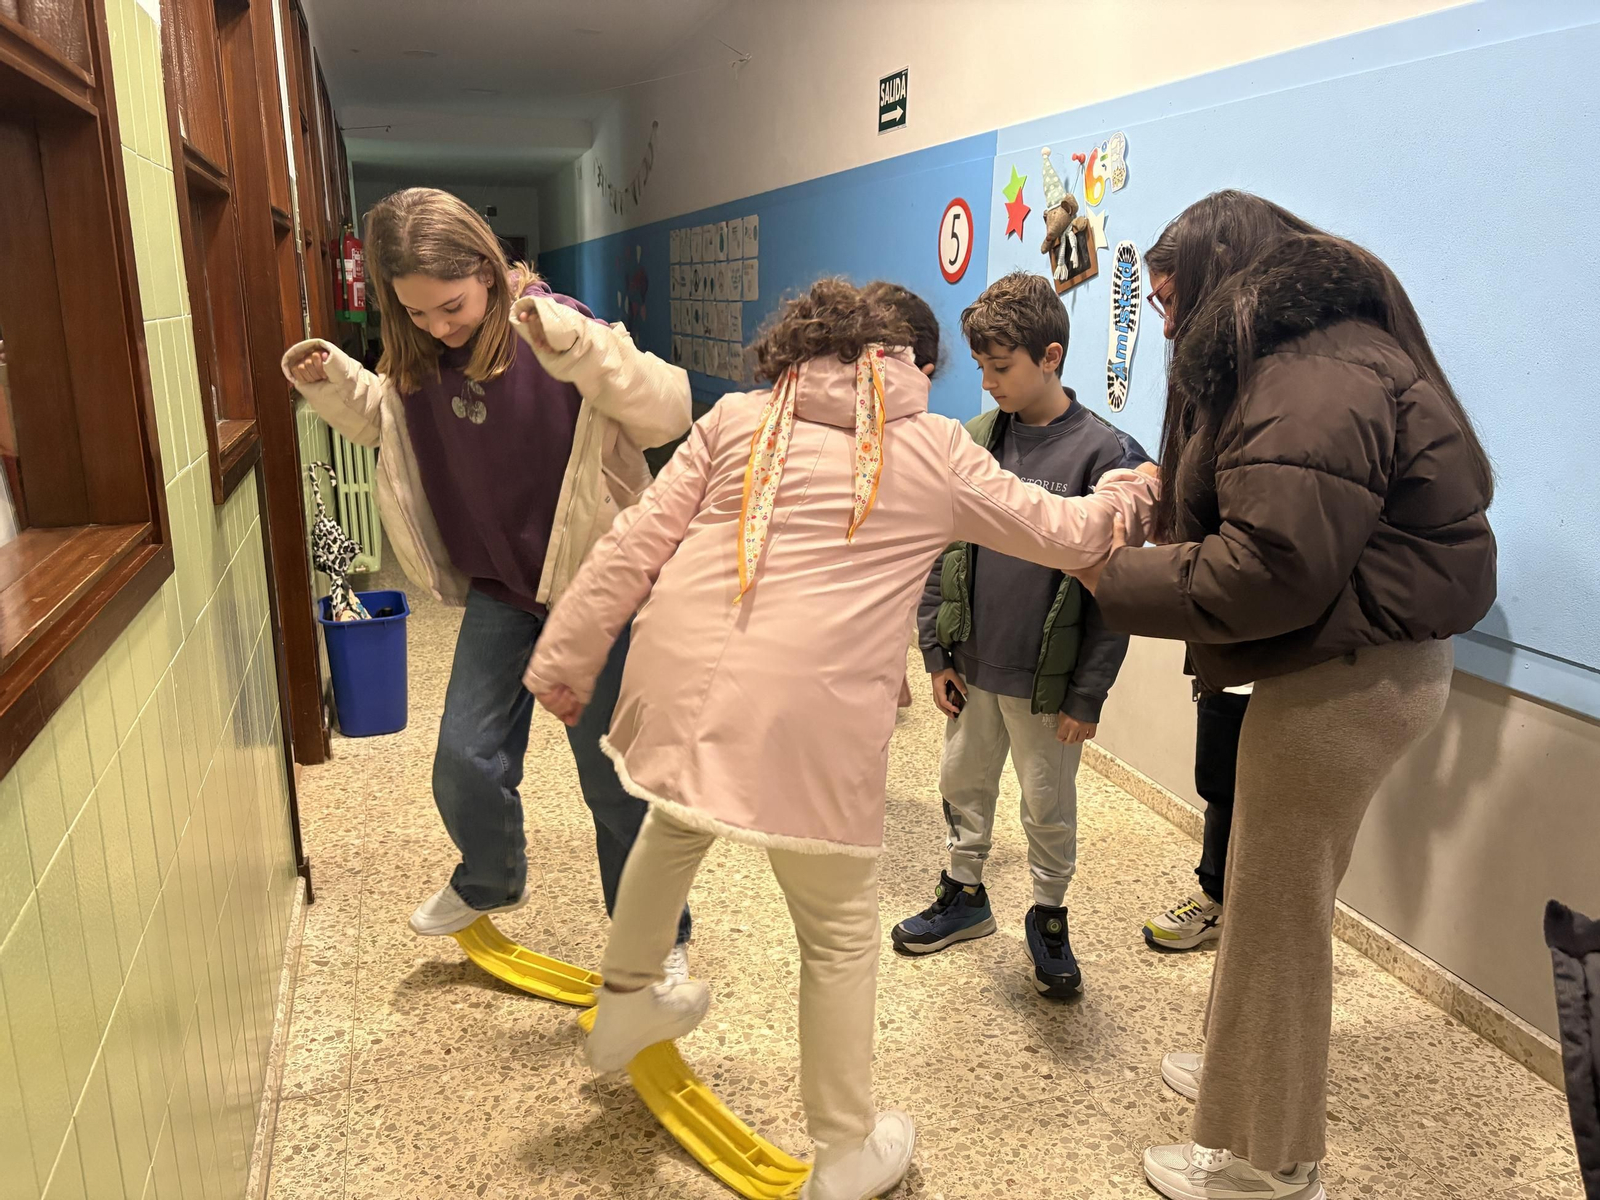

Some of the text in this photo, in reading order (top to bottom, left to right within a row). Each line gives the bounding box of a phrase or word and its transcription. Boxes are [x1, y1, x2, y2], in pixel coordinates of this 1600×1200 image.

[880, 75, 906, 107] SALIDA
[949, 213, 961, 266] 5
[1112, 261, 1133, 381] Amistad
